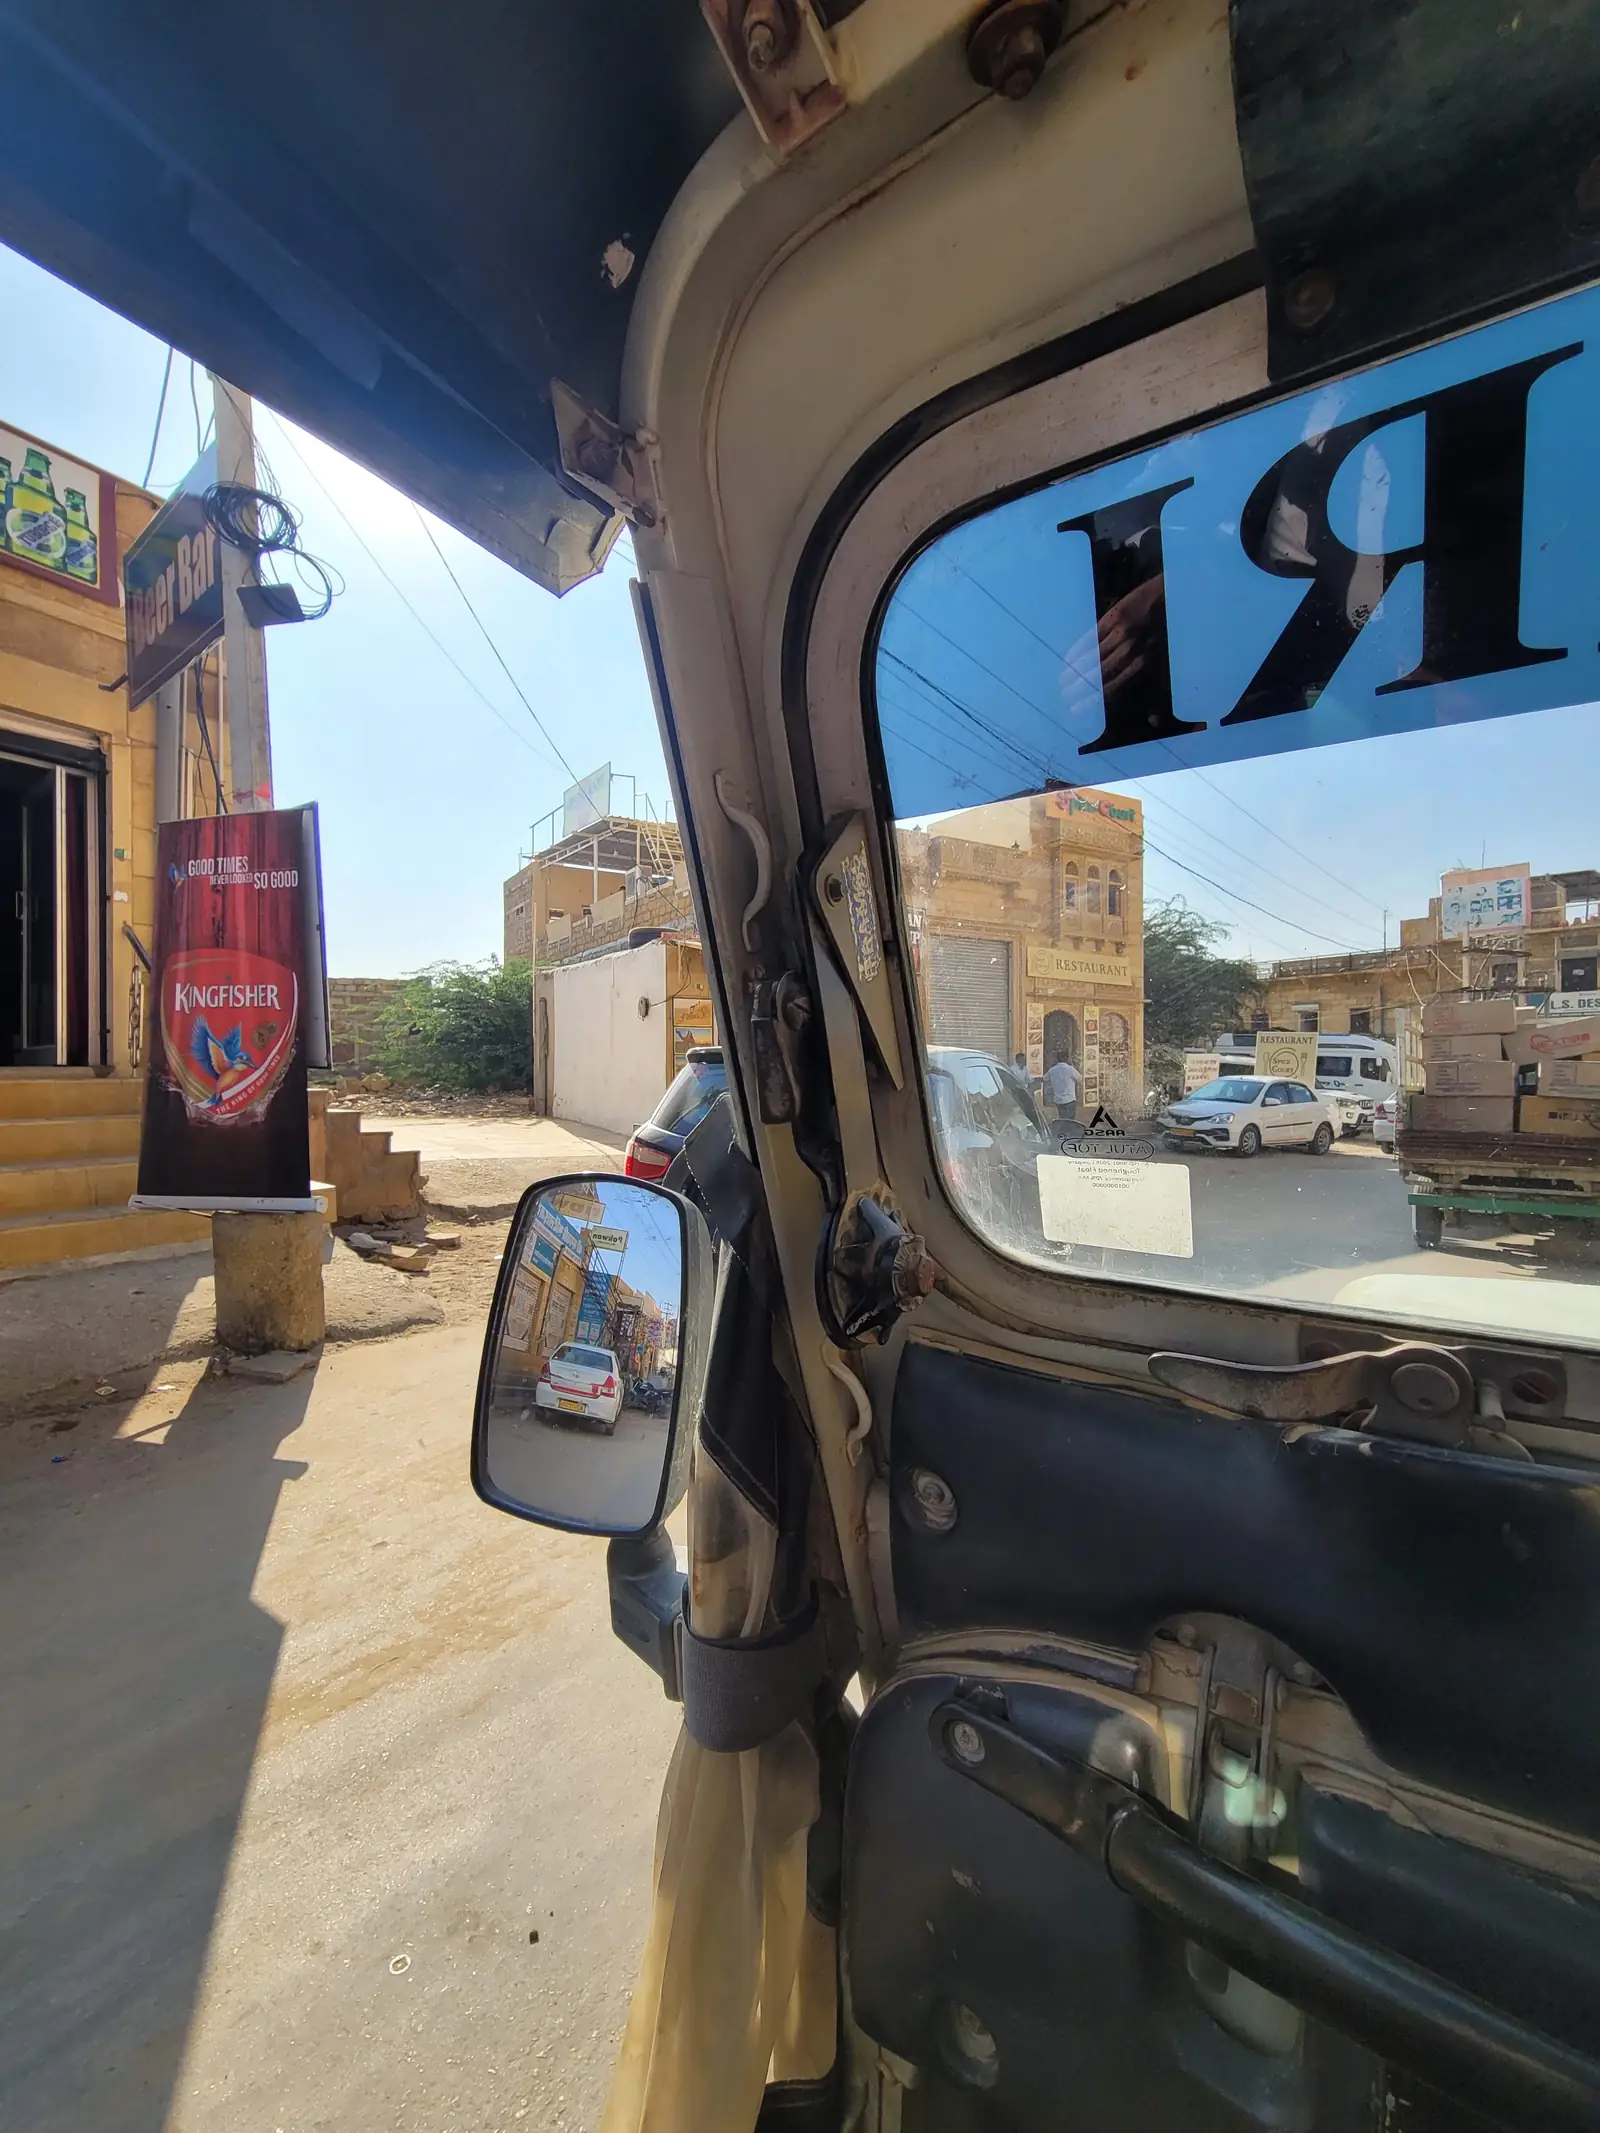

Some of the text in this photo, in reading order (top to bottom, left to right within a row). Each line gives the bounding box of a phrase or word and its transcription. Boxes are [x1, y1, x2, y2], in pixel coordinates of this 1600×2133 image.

[177, 526, 216, 614] Bar
[188, 856, 249, 877] GOOD TIMES
[210, 873, 253, 885] NEVER LOOKED
[254, 870, 298, 889] SO GOOD
[1056, 958, 1129, 977] RESTAURANT
[175, 982, 281, 1014] KINGFISHER
[1260, 1036, 1314, 1045] RESTAURANT
[216, 1102, 230, 1115] THE
[231, 1091, 248, 1106] KING
